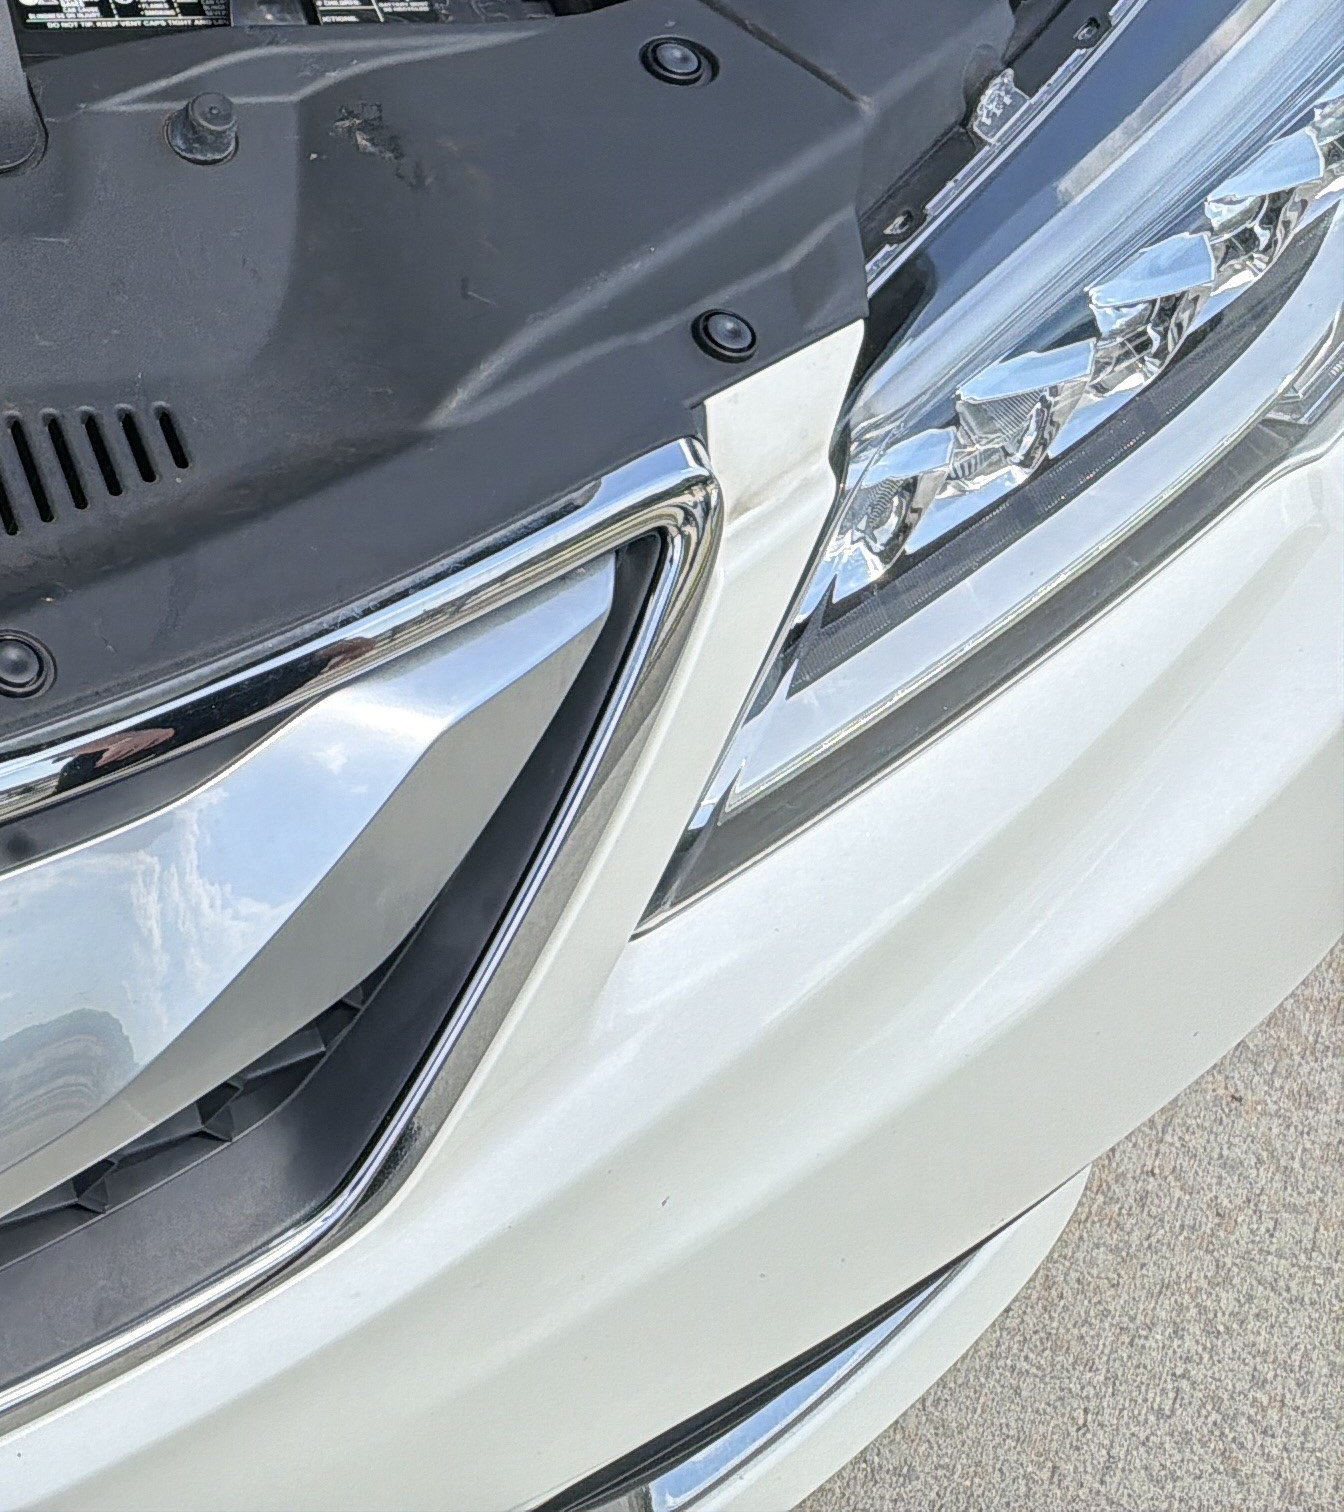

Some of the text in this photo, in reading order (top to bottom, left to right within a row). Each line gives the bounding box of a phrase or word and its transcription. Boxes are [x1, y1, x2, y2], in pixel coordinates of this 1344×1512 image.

[47, 21, 60, 29] DO
[61, 21, 78, 29] NOT
[96, 20, 118, 28] KEEP
[120, 20, 141, 28] VENT
[168, 19, 193, 27] TIGHT
